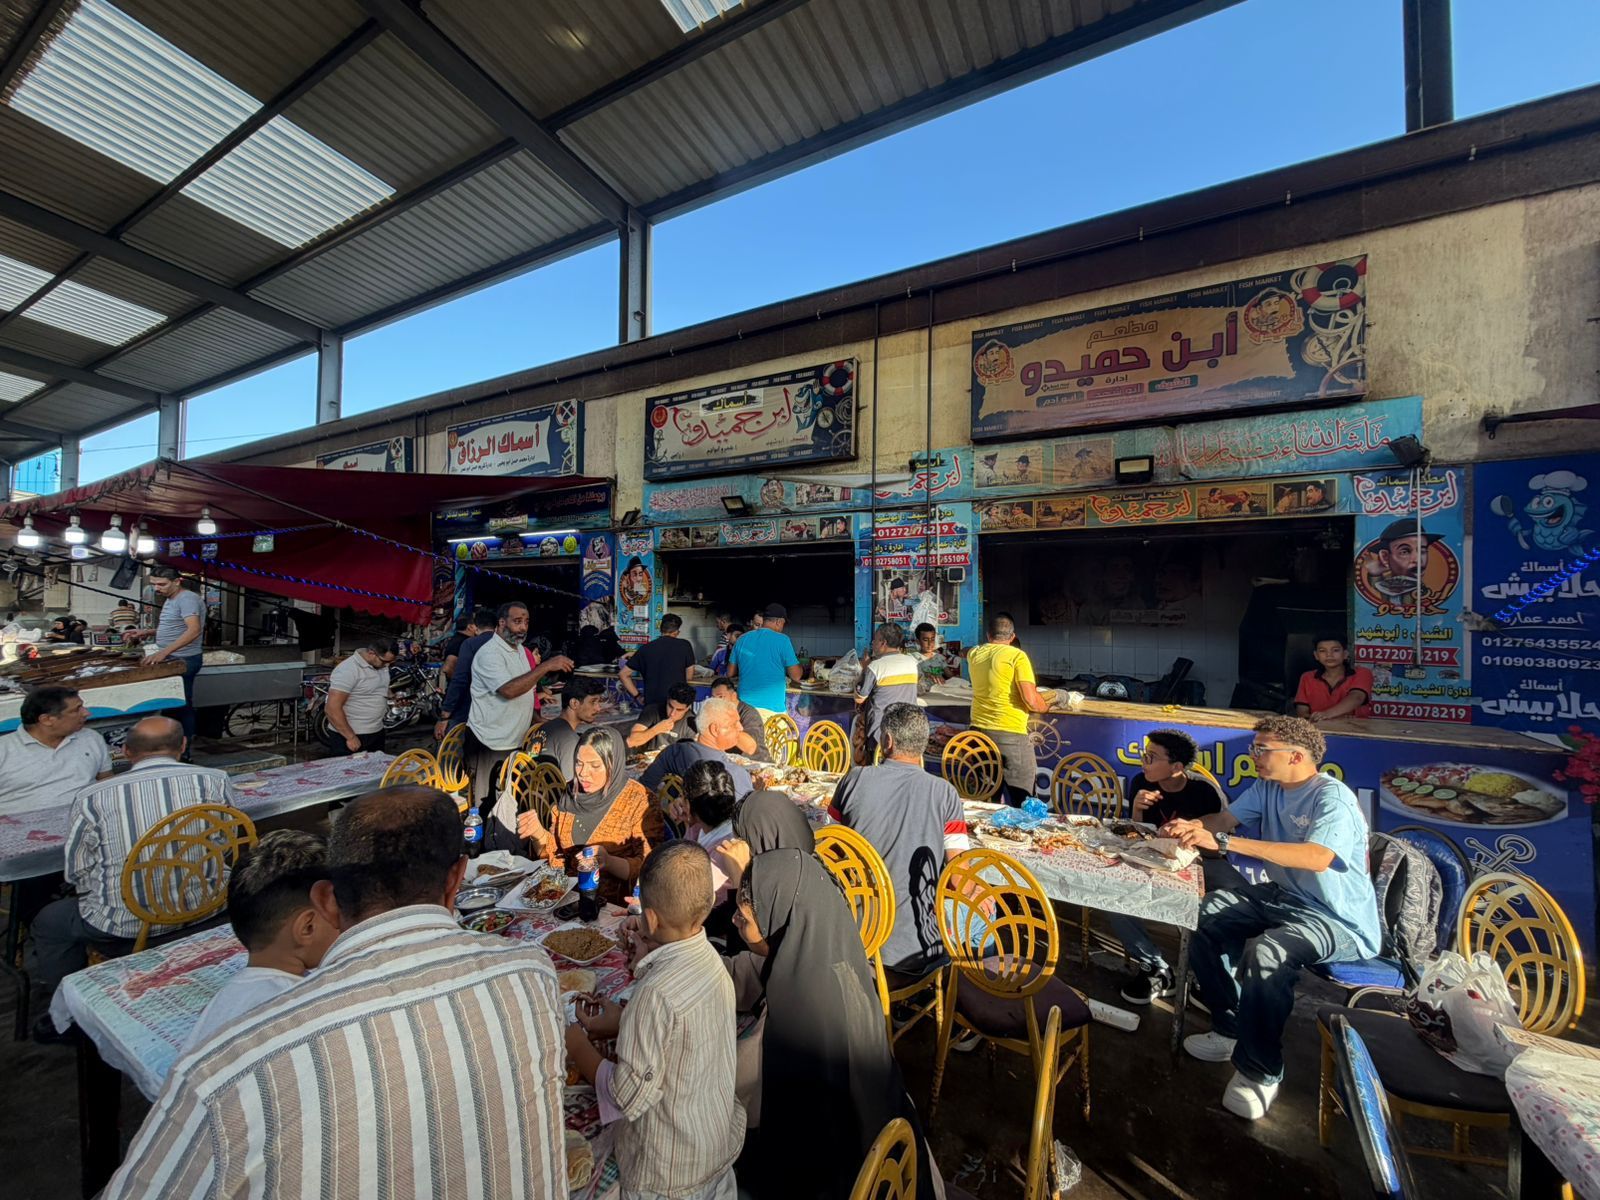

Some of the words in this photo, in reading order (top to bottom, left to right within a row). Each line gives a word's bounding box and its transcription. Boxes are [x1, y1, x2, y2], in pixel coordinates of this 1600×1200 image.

[1239, 280, 1254, 288] FISH
[1254, 275, 1283, 286] MARKET
[1187, 290, 1201, 298] FISH
[1202, 285, 1228, 296] MARKET
[1086, 319, 1159, 350] مطعم
[1020, 346, 1151, 397] حميدو
[671, 407, 764, 447] حميدو
[497, 421, 541, 454] أسماك
[456, 435, 496, 466] الرزاق
[1520, 559, 1564, 572] أسماك
[1358, 648, 1450, 662] 0127207219
[1481, 655, 1600, 670] 01090380923
[1411, 683, 1446, 698] الشيف
[1519, 678, 1564, 692] أسماك
[1373, 703, 1467, 719] 01272078219
